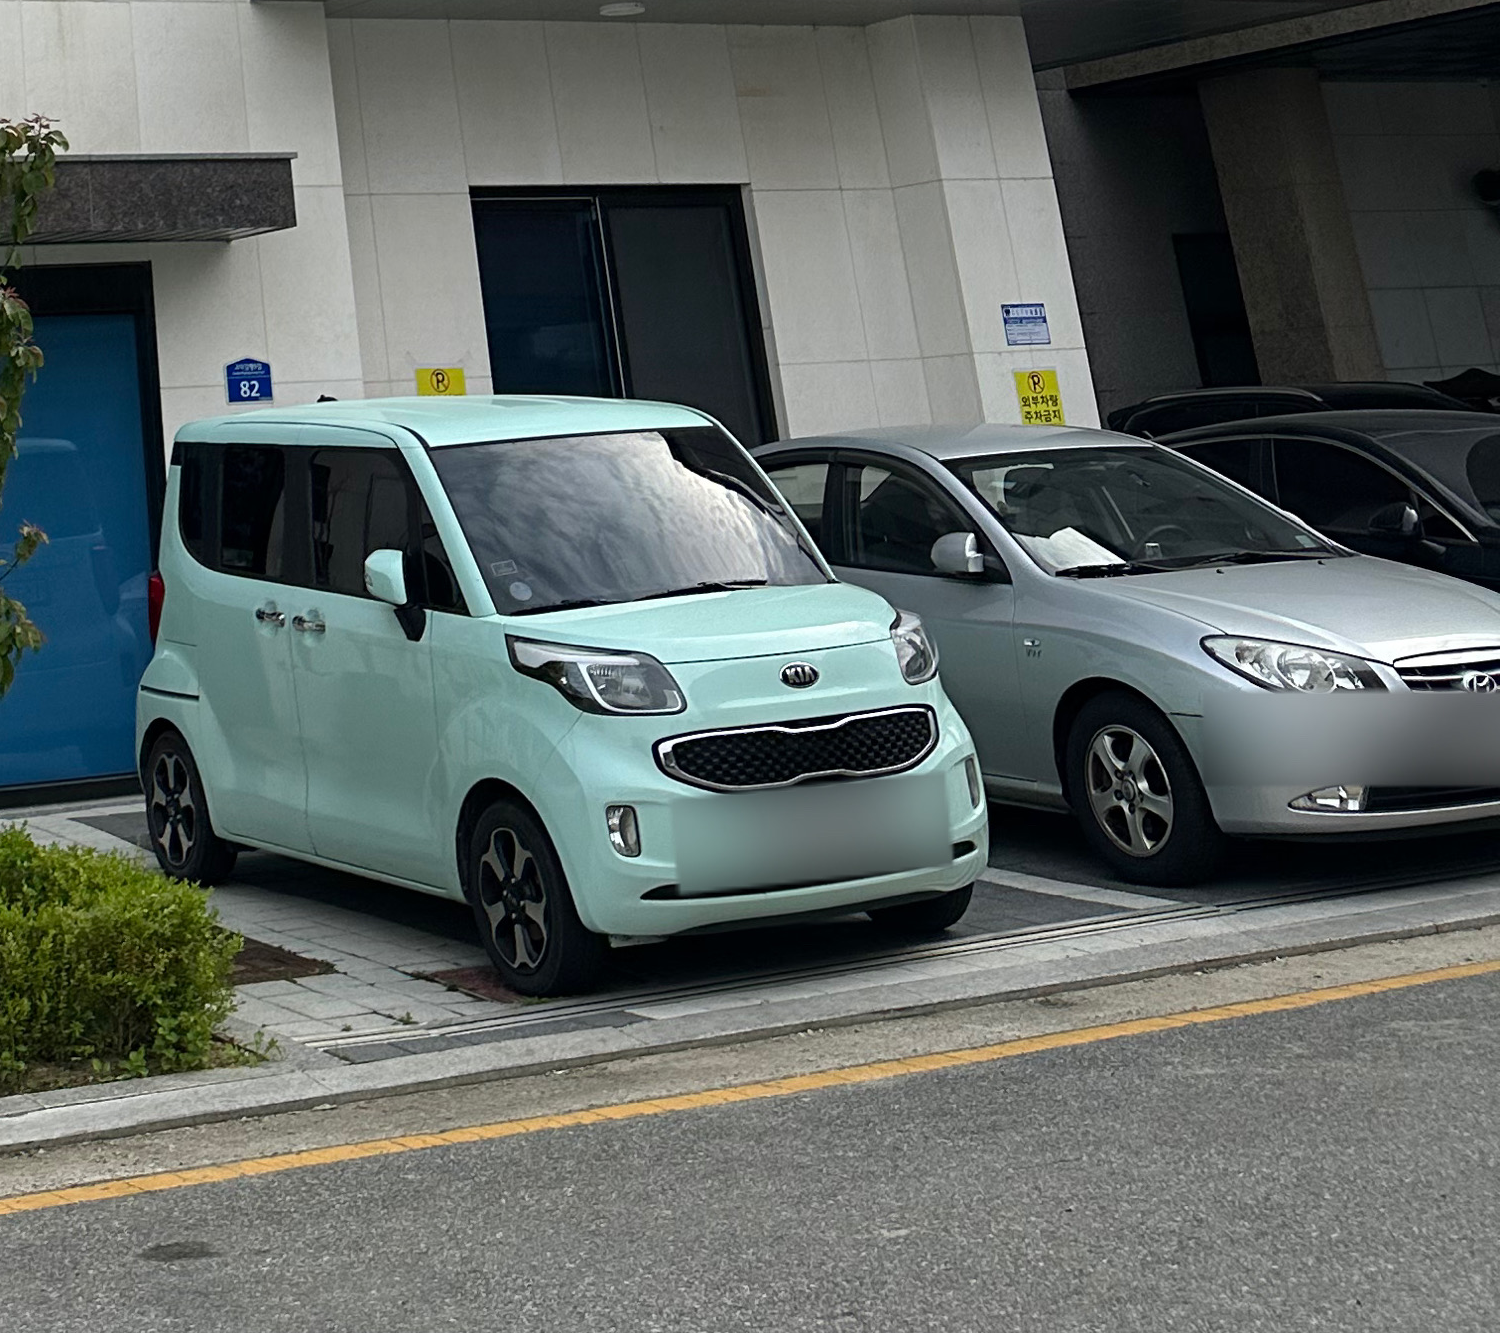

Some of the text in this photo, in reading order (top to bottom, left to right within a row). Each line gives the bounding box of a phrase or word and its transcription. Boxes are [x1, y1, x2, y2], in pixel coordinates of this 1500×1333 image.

[240, 380, 260, 398] 82
[1021, 394, 1058, 409] 외부차량
[1024, 408, 1062, 424] 주차금지
[785, 665, 815, 684] KIA
